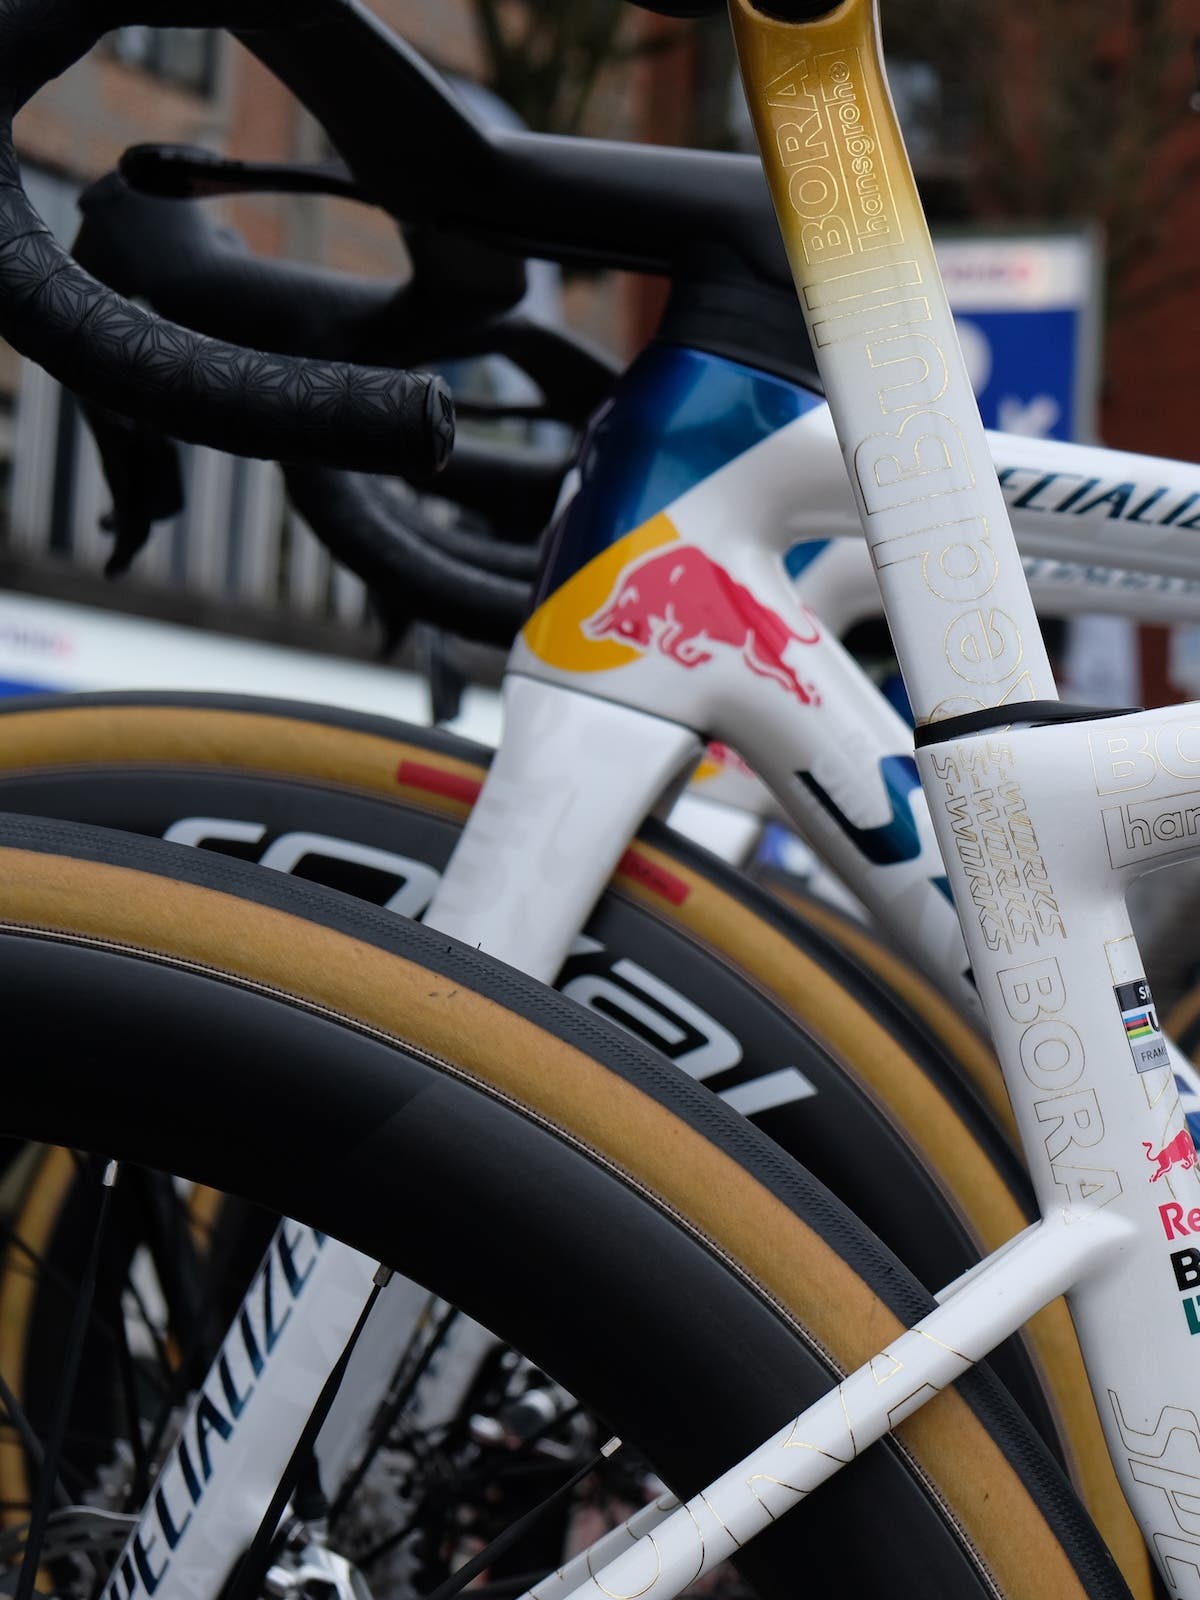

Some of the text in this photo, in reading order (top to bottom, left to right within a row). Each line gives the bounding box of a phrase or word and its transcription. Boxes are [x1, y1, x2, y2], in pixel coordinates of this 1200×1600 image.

[764, 59, 854, 265] BORA
[826, 60, 890, 239] hansgrohe
[803, 260, 976, 516] Bull
[931, 753, 1013, 955] S-WORKS
[957, 743, 1041, 947] S-WORKS
[986, 739, 1068, 939] S-WORKS
[996, 956, 1124, 1226] BORA
[1140, 1046, 1168, 1062] FRAM
[90, 1222, 326, 1600] PECIALIZE
